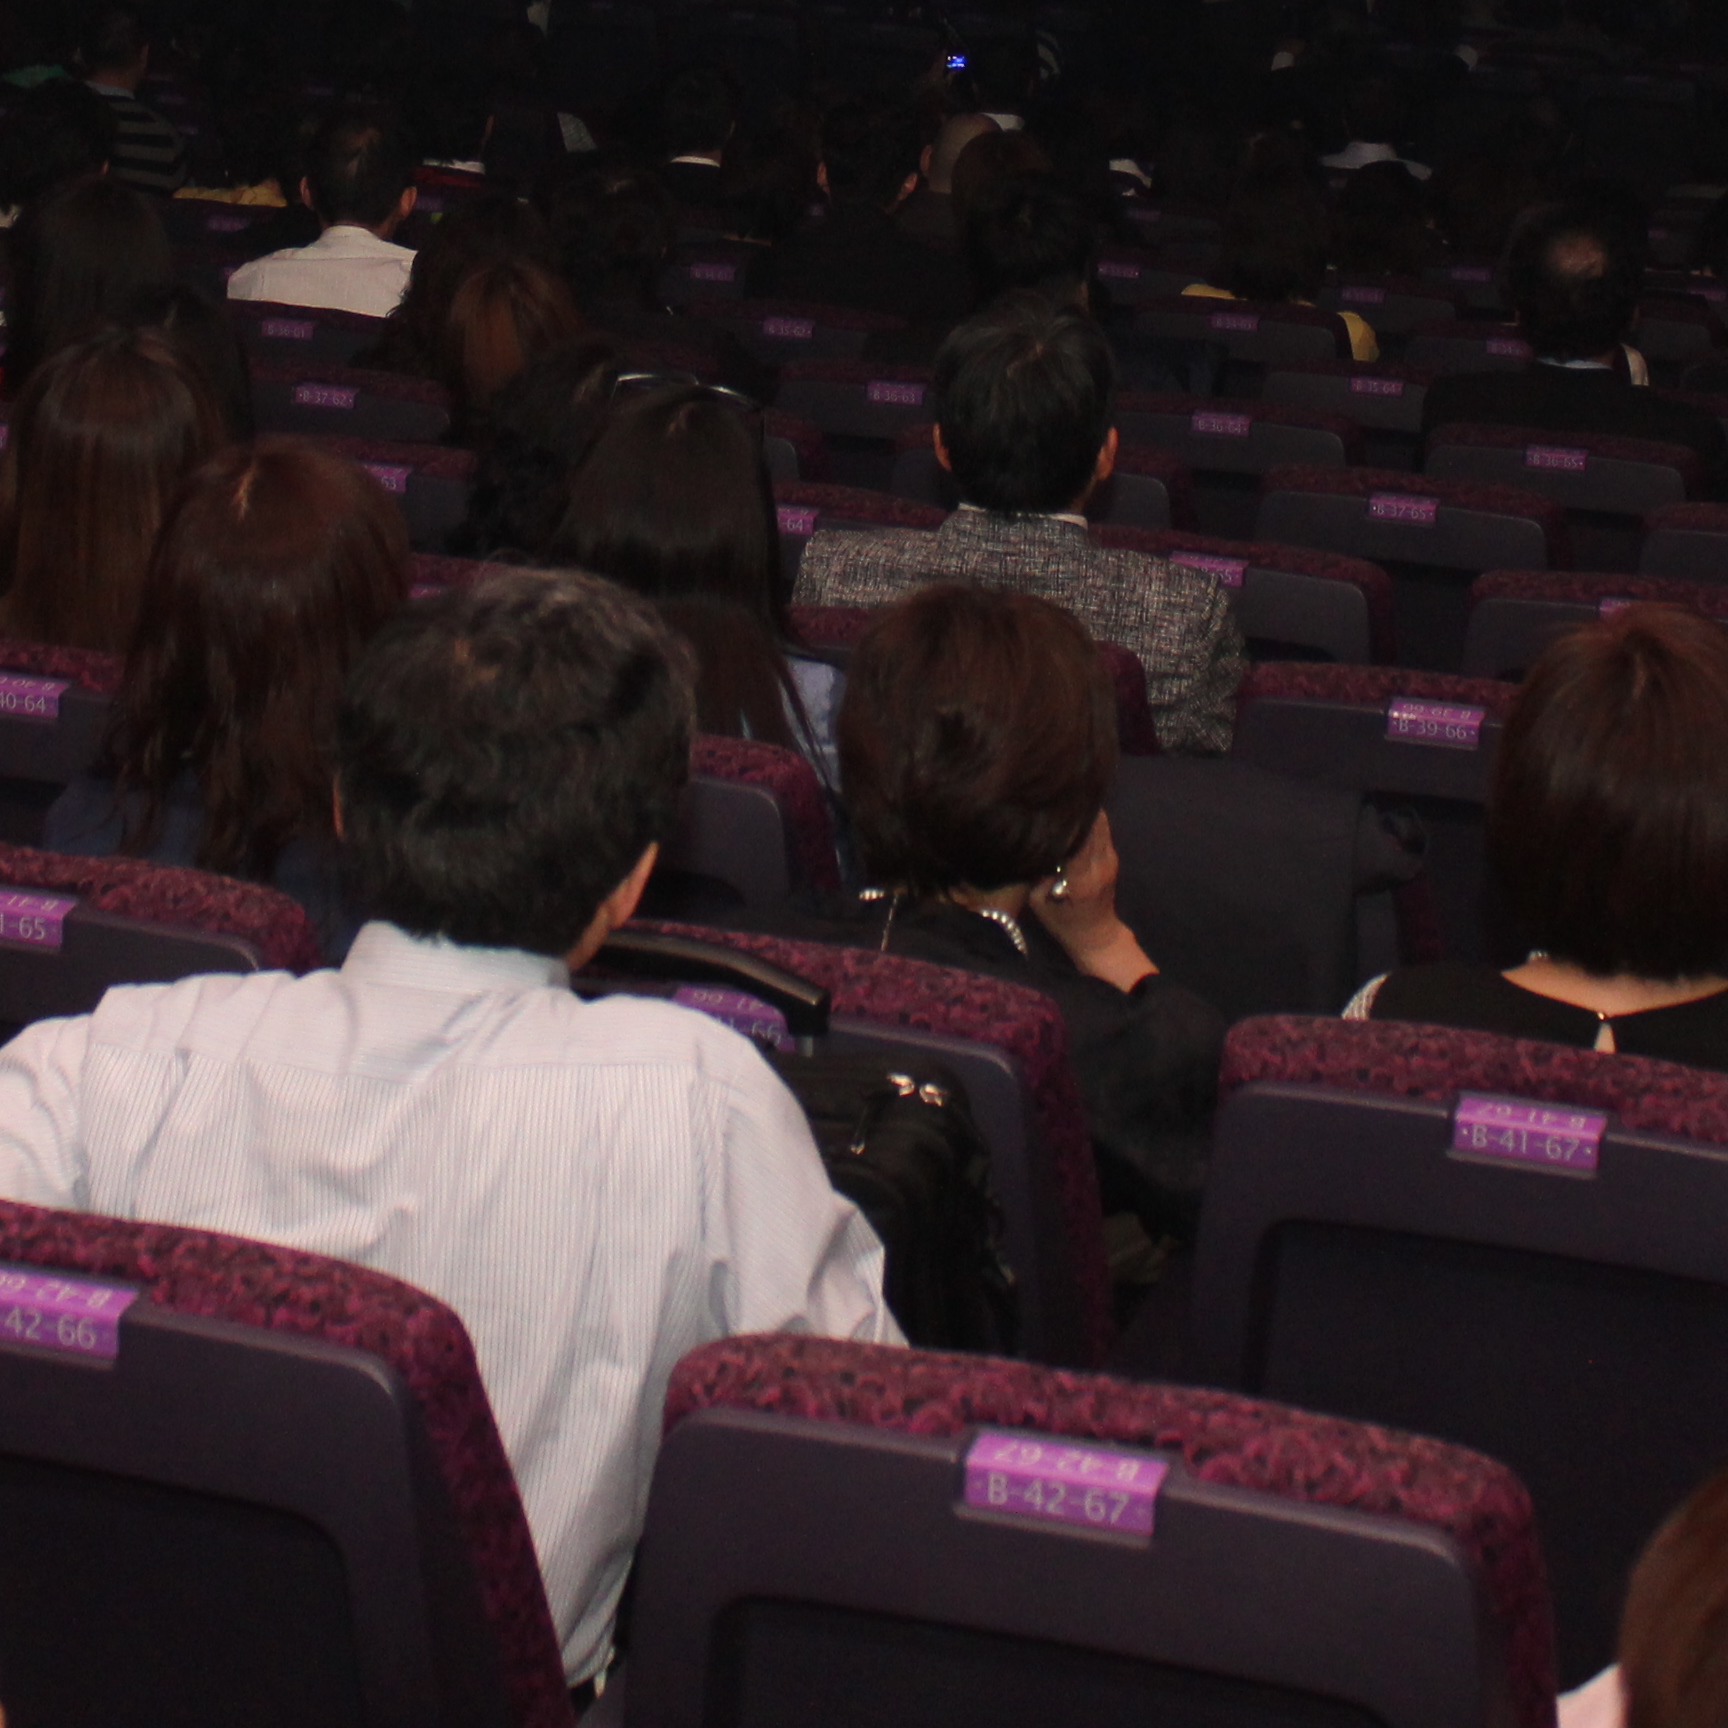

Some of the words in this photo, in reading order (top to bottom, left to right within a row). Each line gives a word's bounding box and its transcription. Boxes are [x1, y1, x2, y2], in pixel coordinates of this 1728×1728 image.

[1398, 718, 1468, 741] B-39-66
[1471, 1119, 1581, 1155] B-41-67
[988, 1472, 1130, 1525] B-42-67
